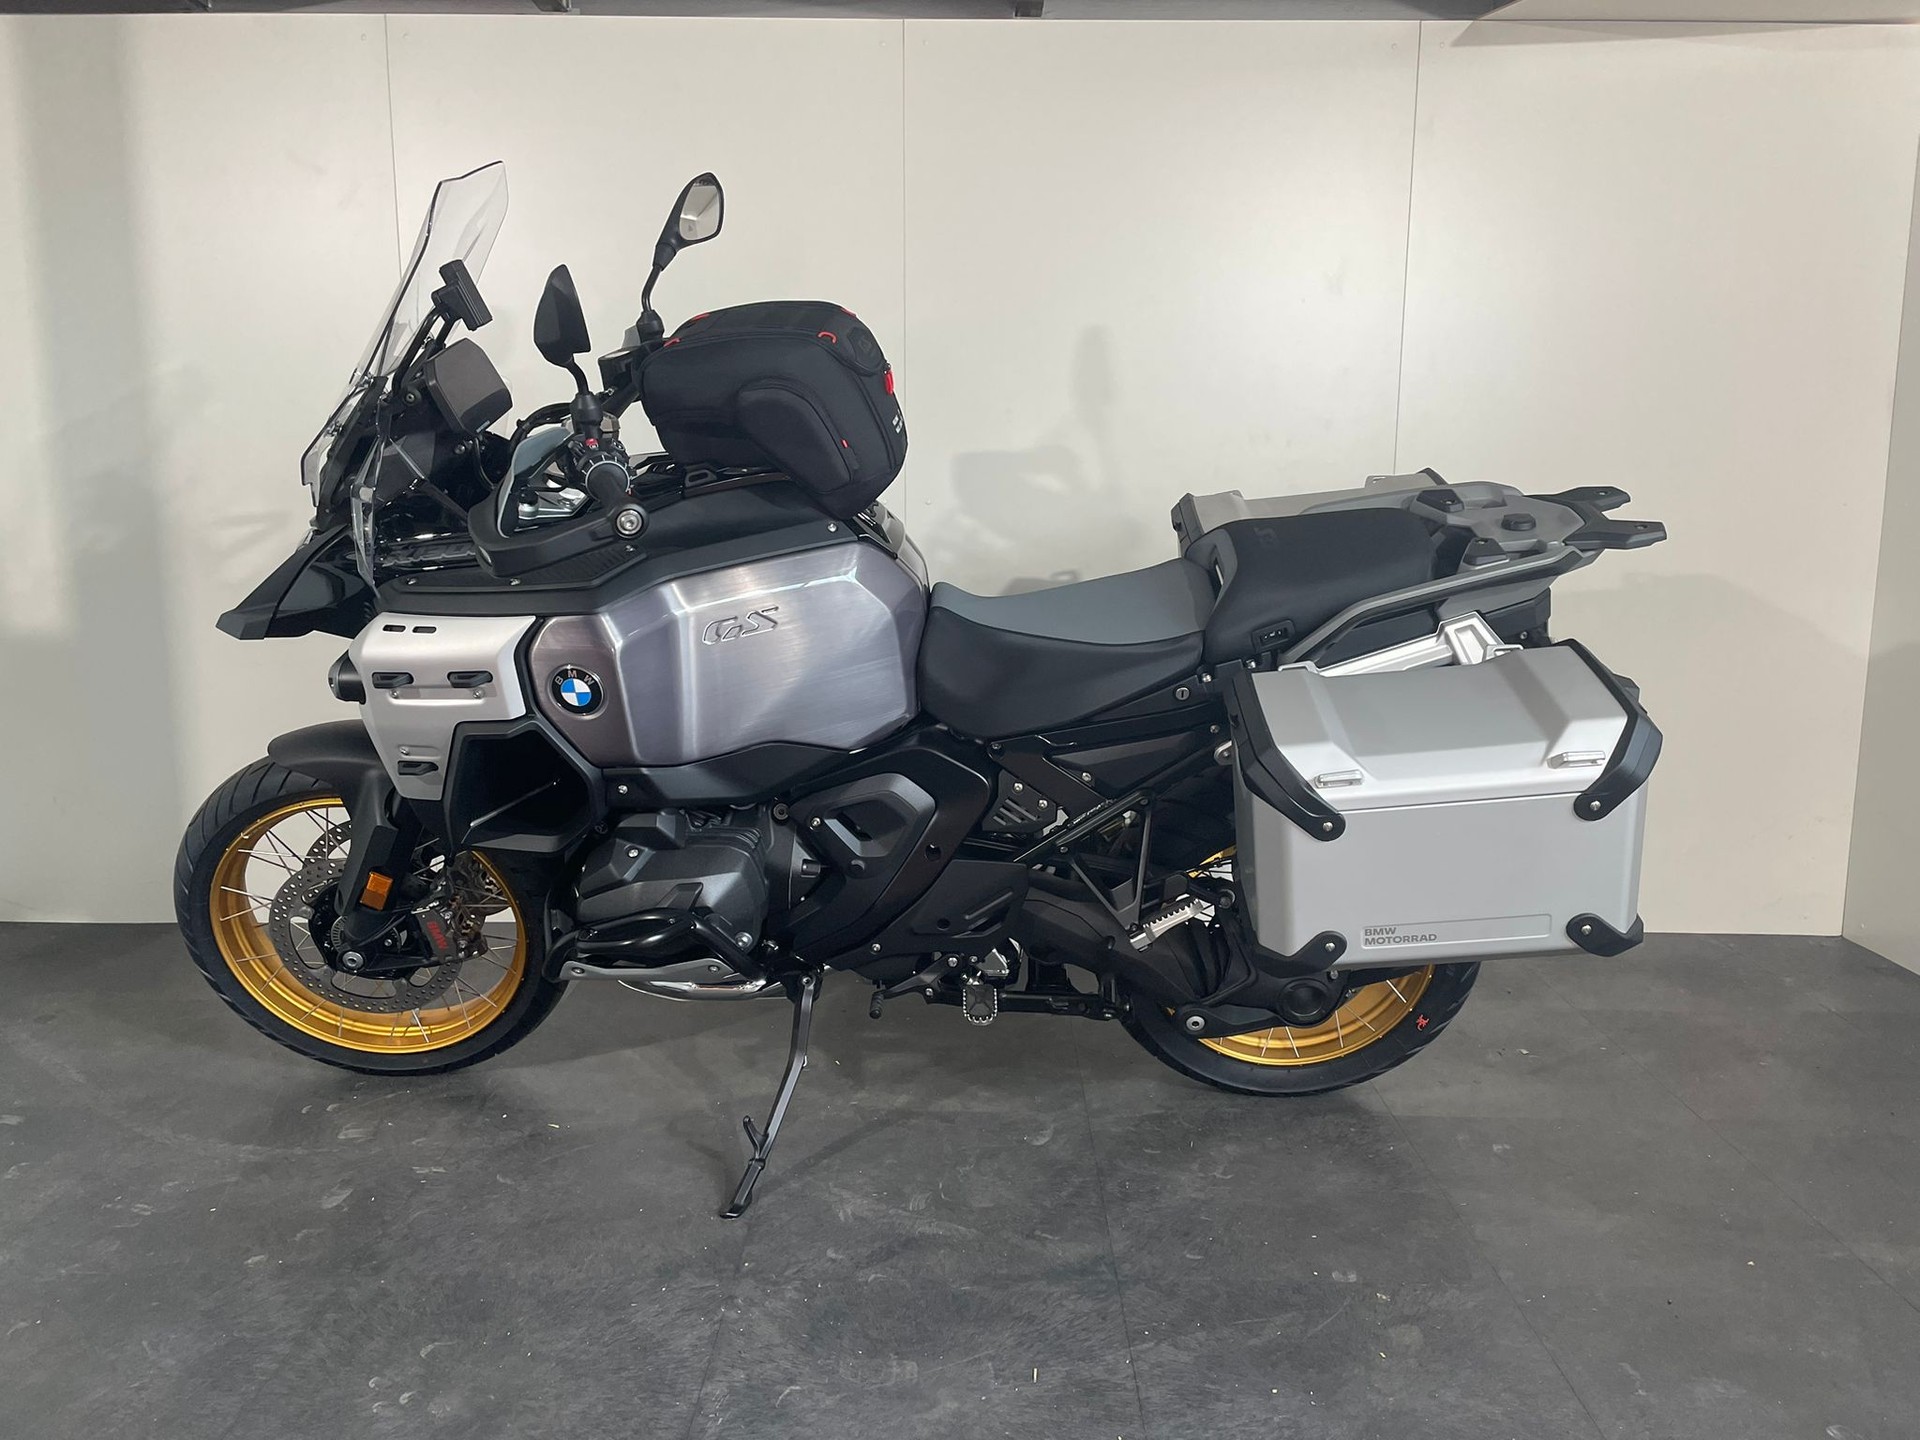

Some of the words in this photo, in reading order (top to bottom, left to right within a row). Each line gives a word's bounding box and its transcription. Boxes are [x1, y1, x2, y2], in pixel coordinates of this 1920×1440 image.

[702, 605, 779, 645] GS
[554, 669, 595, 686] BMW
[1364, 927, 1397, 936] BMW
[1364, 933, 1438, 945] MOTORRAD
